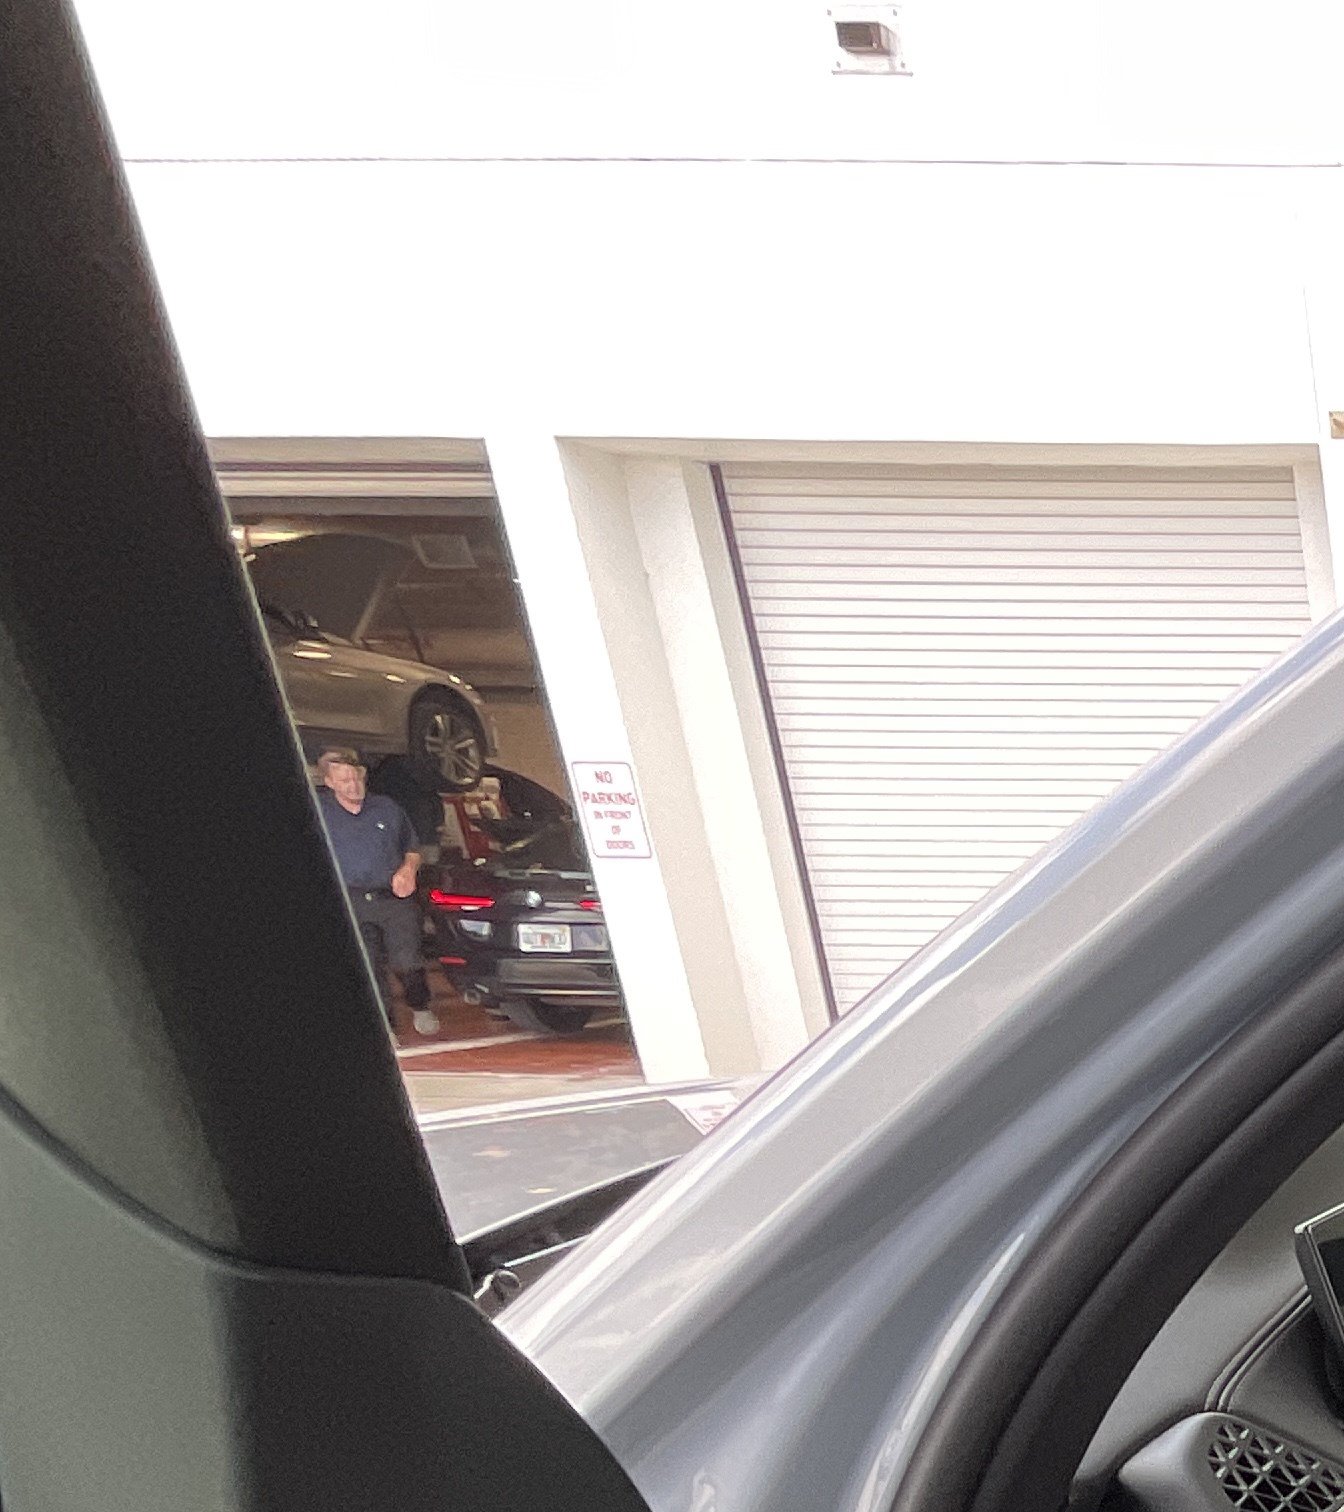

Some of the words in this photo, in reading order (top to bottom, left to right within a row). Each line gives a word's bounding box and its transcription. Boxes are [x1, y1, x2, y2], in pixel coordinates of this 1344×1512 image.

[594, 770, 613, 784] NO
[582, 791, 637, 805] PARKING
[604, 810, 632, 820] FRONT
